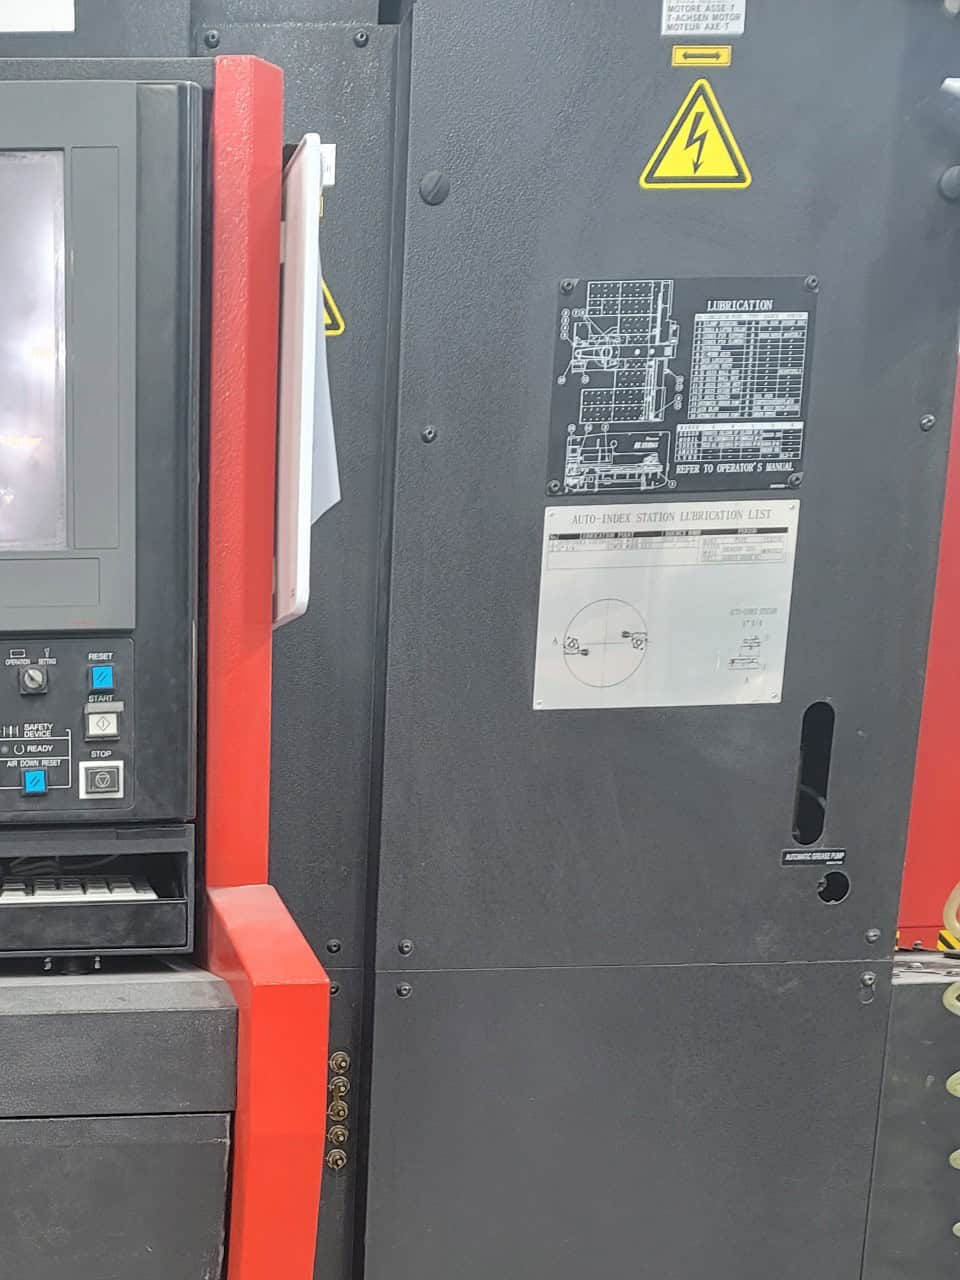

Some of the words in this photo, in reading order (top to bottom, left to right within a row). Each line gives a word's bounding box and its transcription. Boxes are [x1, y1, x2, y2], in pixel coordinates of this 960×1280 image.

[712, 13, 742, 21] MOTOR
[667, 23, 700, 31] MOTEUR
[707, 300, 773, 311] LUBRICATION
[676, 464, 700, 474] REFER
[704, 463, 714, 473] TO
[572, 513, 630, 525] AUTO-INDEX
[637, 511, 675, 523] STATION
[680, 510, 744, 521] LUBRICATION
[748, 508, 773, 520] LIST
[91, 750, 112, 758] STOP
